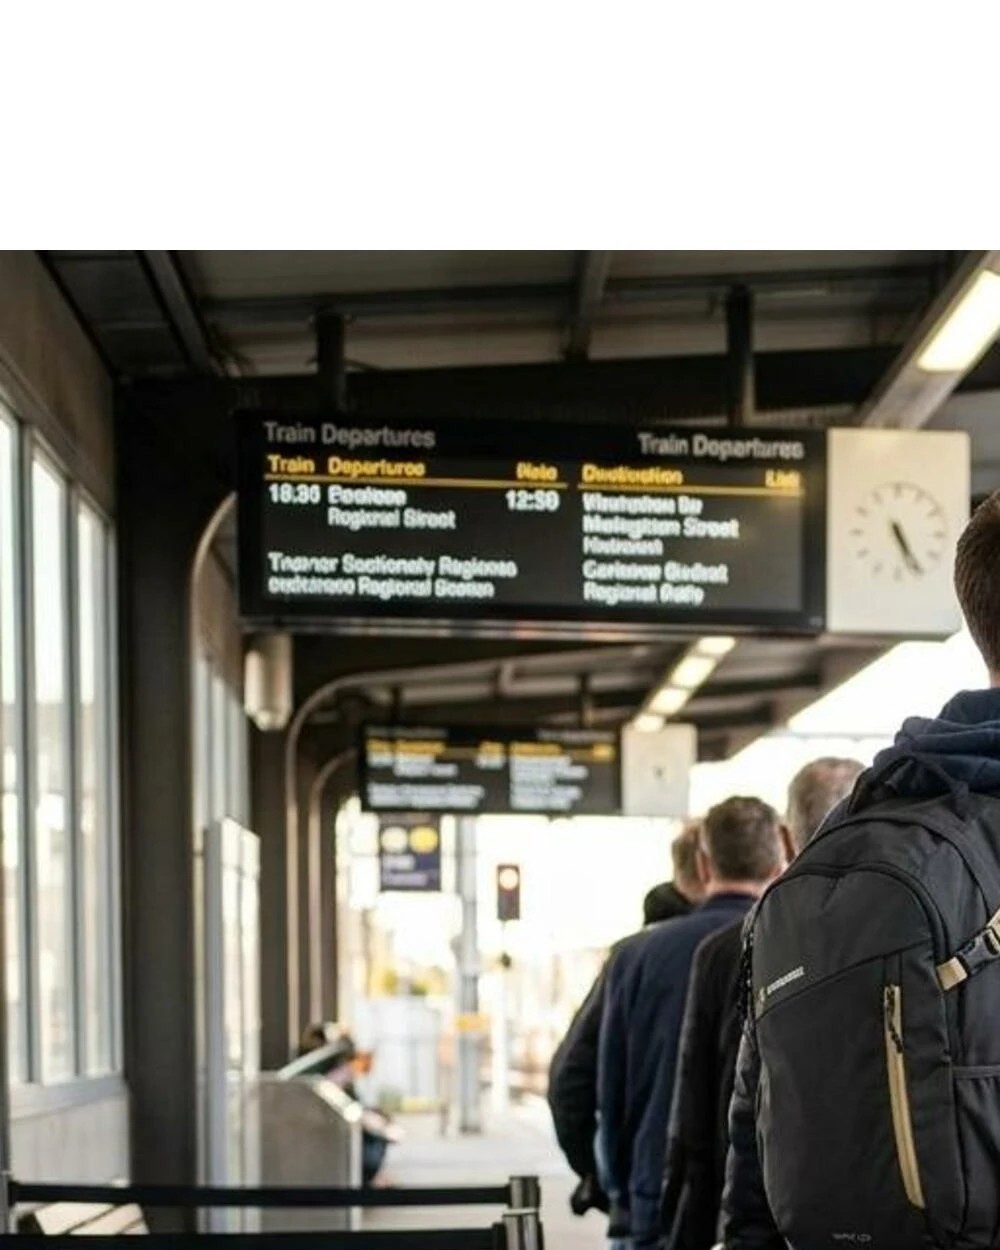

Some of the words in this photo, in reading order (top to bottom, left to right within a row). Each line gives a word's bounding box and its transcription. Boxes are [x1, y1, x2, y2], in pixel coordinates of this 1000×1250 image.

[264, 421, 316, 443] Train
[321, 423, 435, 449] Departures
[637, 432, 689, 455] Train
[266, 454, 315, 473] Train
